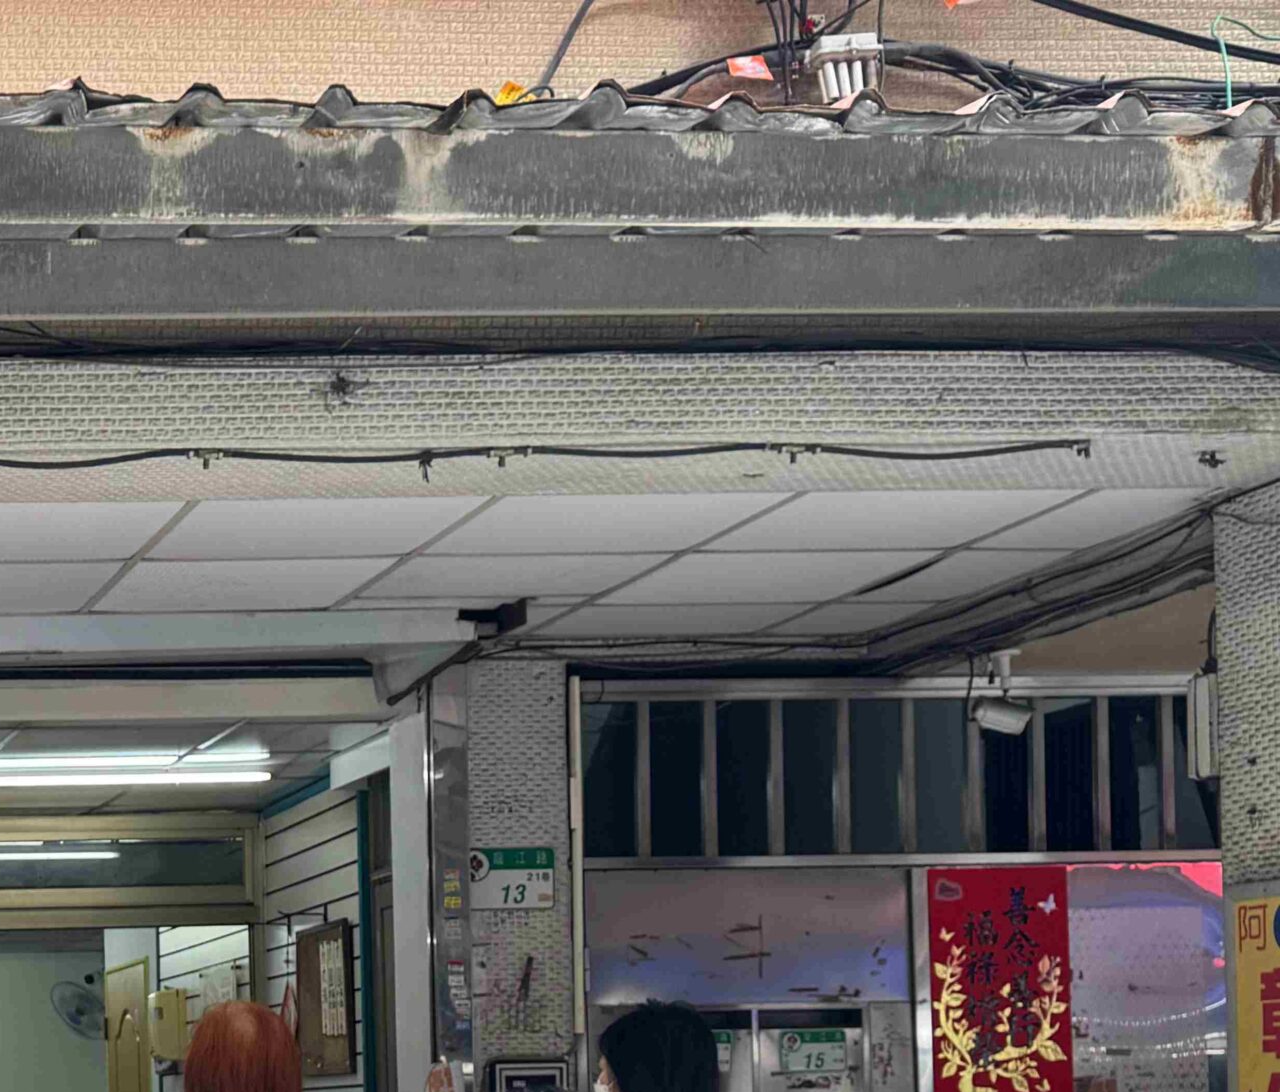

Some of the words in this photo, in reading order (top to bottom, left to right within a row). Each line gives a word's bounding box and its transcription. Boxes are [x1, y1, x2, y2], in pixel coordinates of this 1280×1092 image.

[501, 884, 527, 905] 13
[1238, 904, 1268, 952] 阿
[803, 1052, 826, 1069] 15
